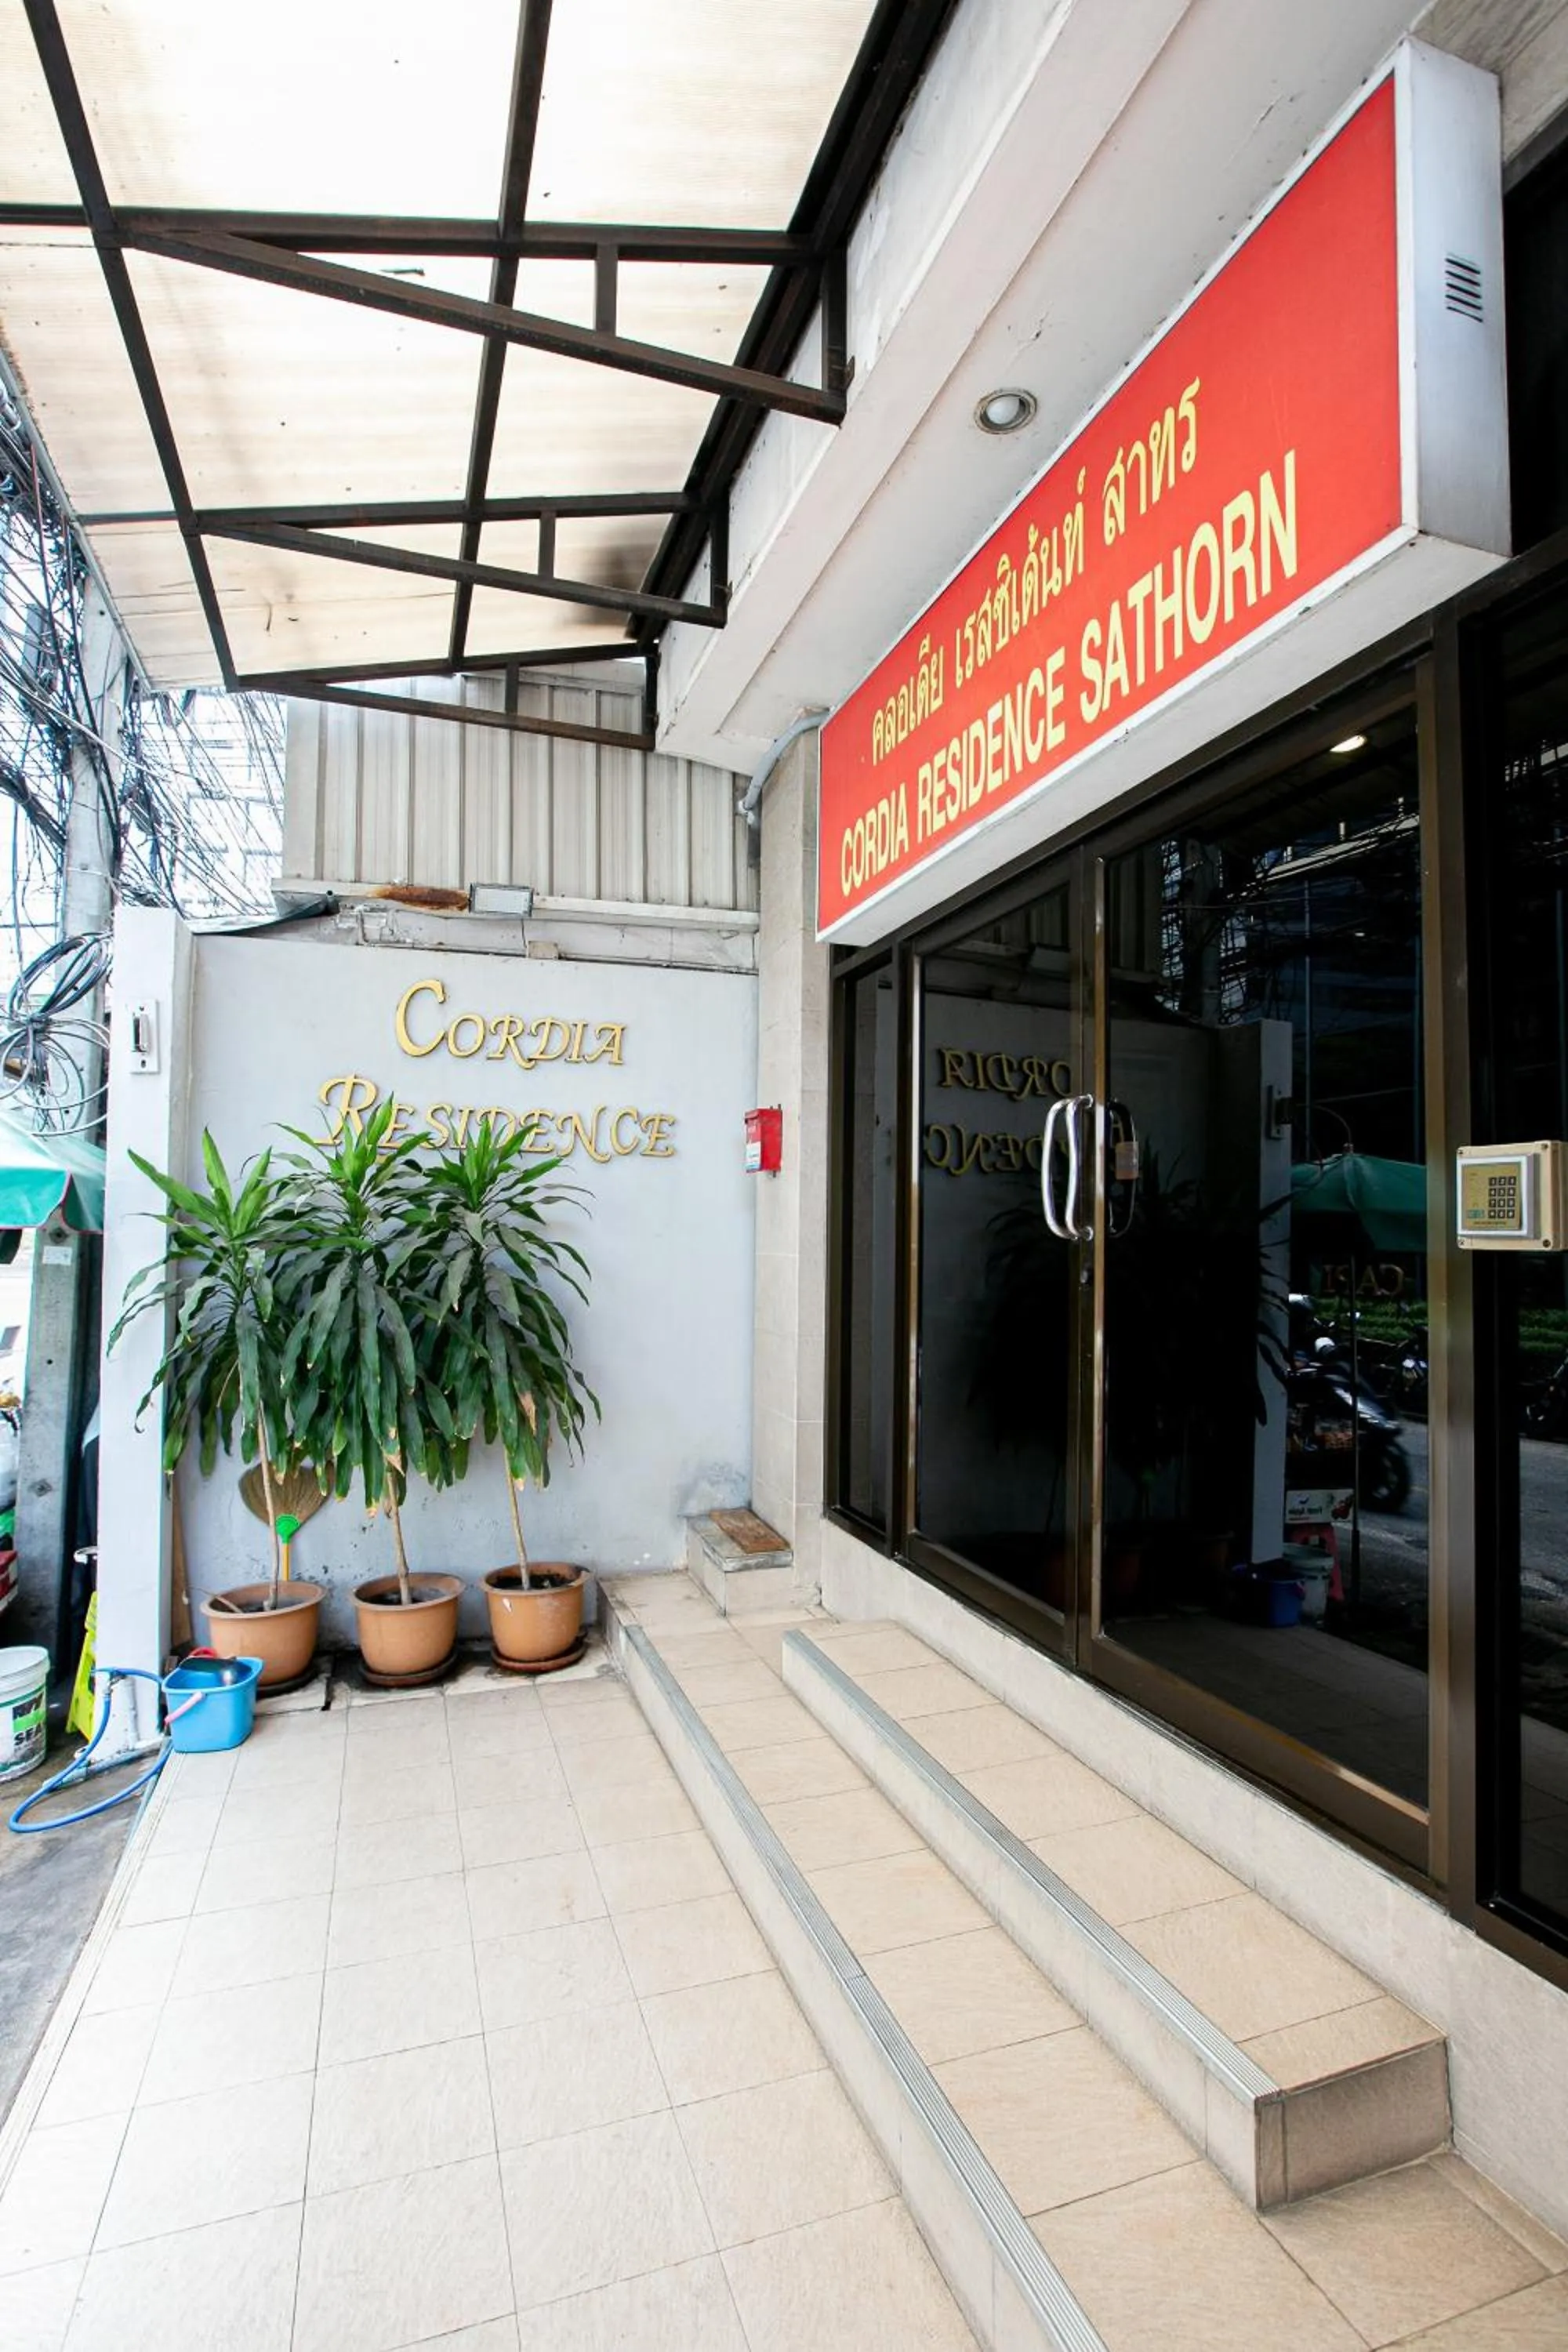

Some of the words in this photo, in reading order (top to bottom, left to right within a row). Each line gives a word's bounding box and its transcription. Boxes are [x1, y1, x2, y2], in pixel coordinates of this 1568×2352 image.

[1102, 376, 1201, 546] สาทร
[840, 782, 909, 897] CORDIA
[917, 646, 1066, 844] RESIDENCE
[1080, 449, 1298, 724] SATHORN
[395, 978, 627, 1070] CORDIA
